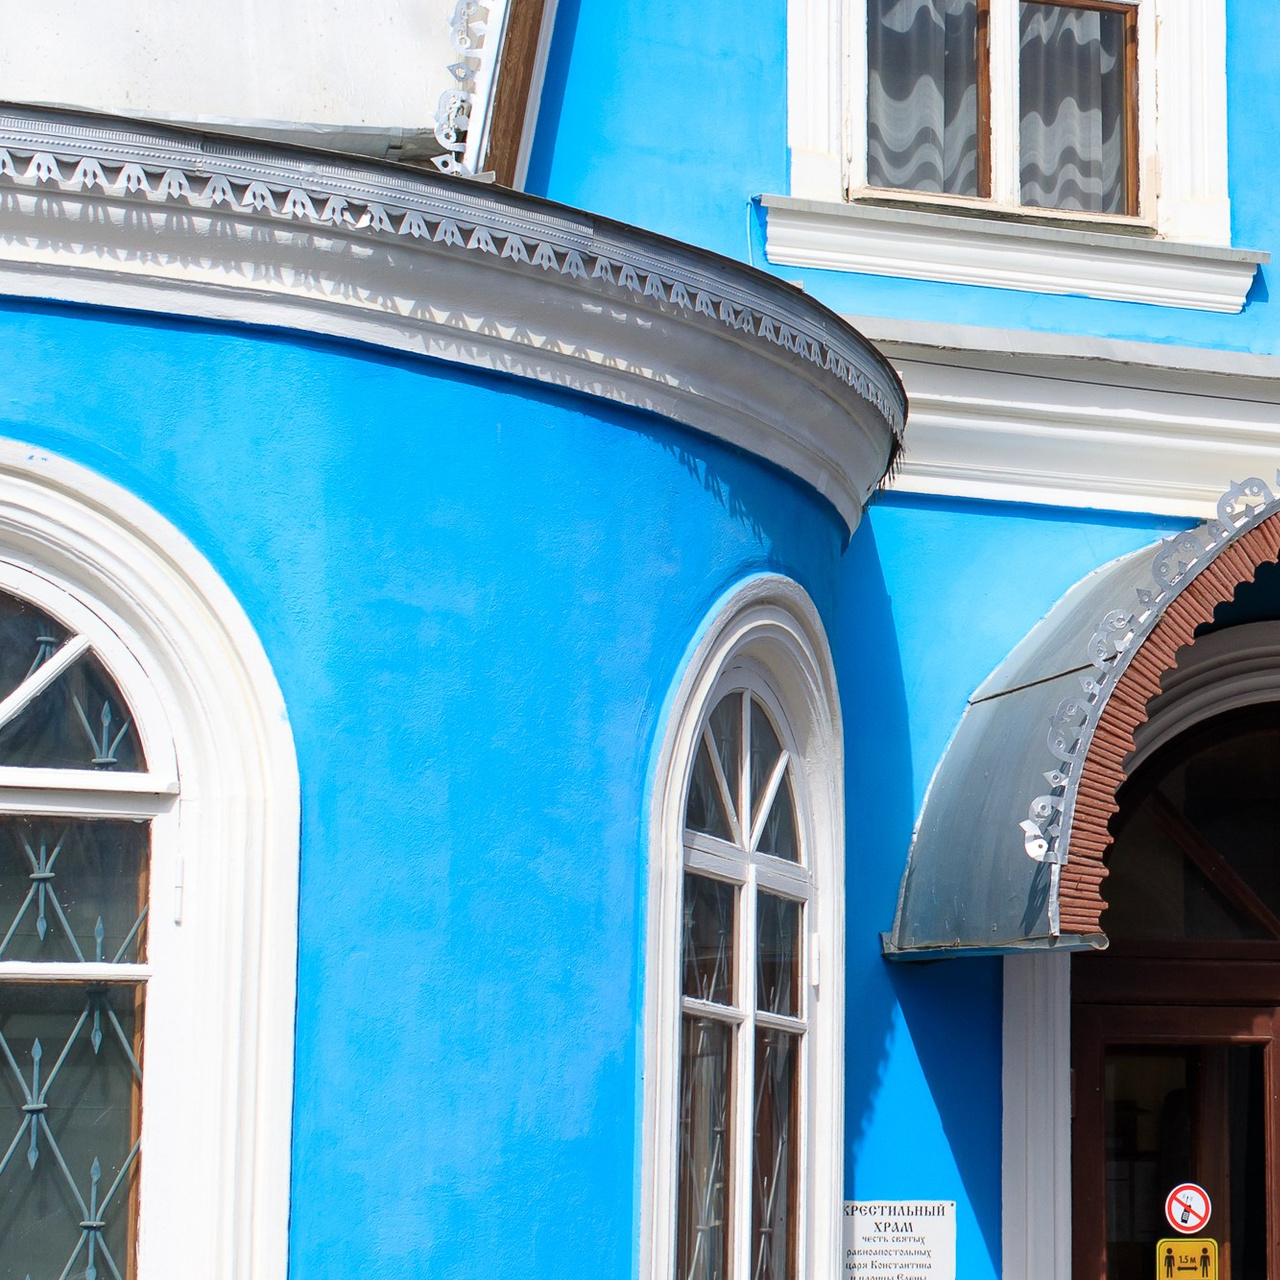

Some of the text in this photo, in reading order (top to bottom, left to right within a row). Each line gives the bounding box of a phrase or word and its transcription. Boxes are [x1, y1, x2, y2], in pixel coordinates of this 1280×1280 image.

[874, 1222, 913, 1233] ХРАМ
[892, 1236, 925, 1245] святых
[845, 1260, 932, 1270] царя Константина
